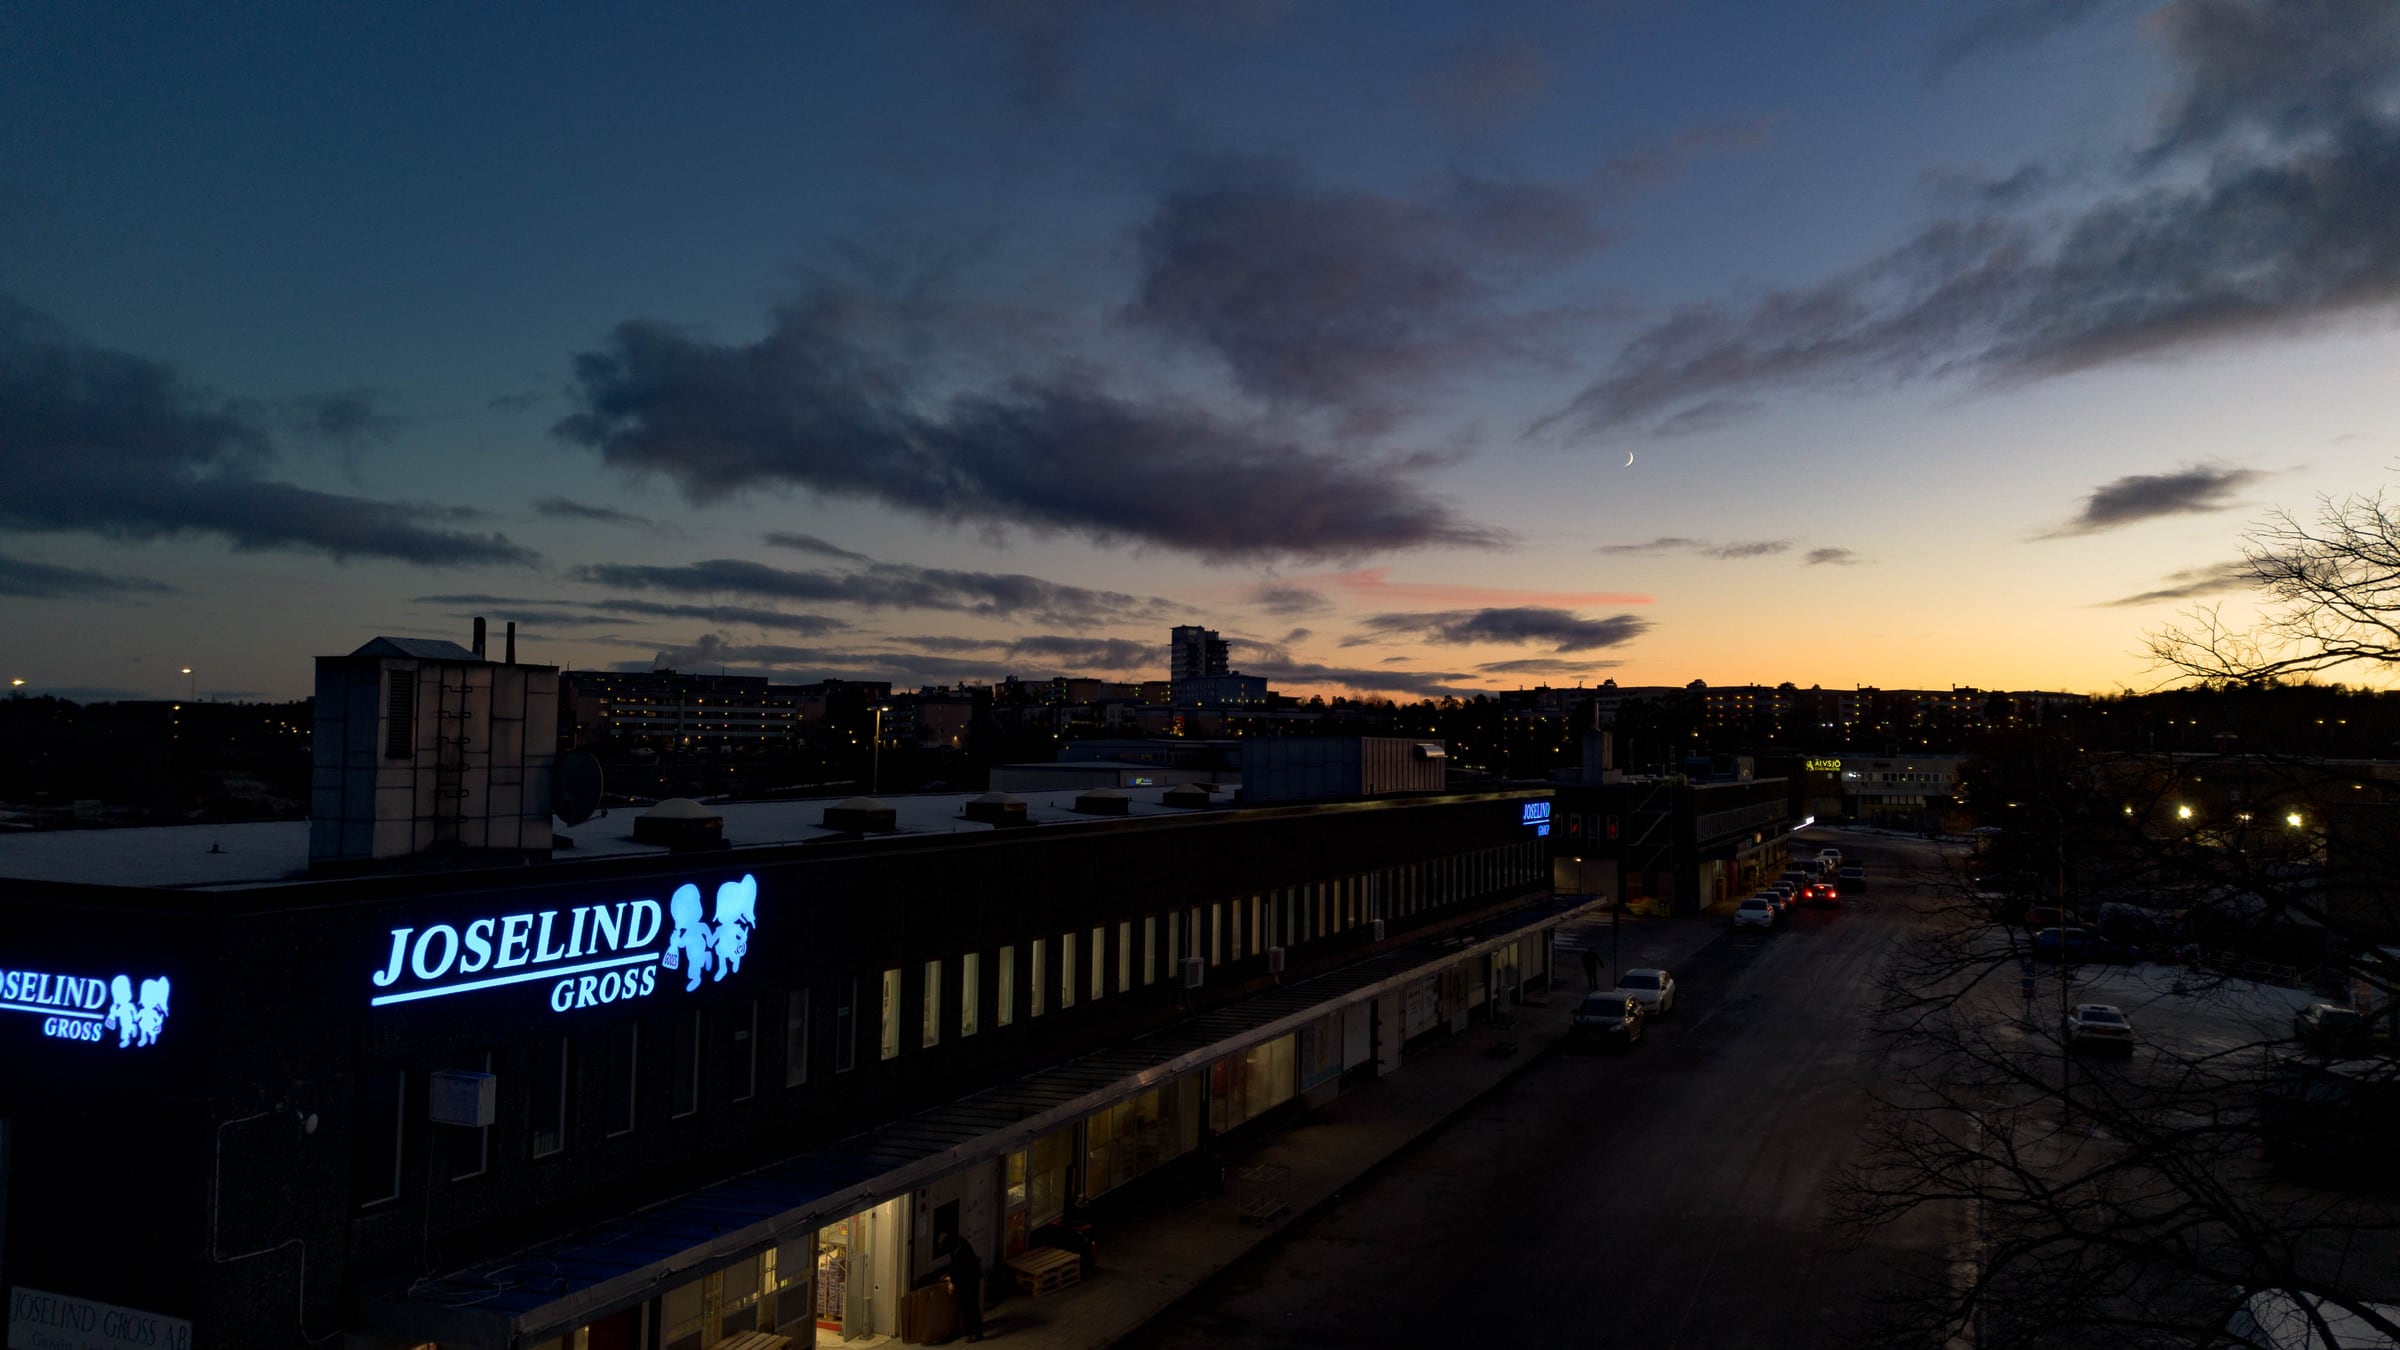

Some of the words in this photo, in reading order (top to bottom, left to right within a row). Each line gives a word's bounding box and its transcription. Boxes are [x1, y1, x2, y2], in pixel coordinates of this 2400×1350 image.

[1523, 802, 1551, 820] JOSELIND
[372, 898, 662, 987] JOSELIND
[550, 965, 657, 1013] GROSS
[44, 1016, 103, 1042] GROSS
[12, 1294, 96, 1333] JOSELIND
[103, 1310, 160, 1347] GROSS
[162, 1325, 188, 1350] AB
